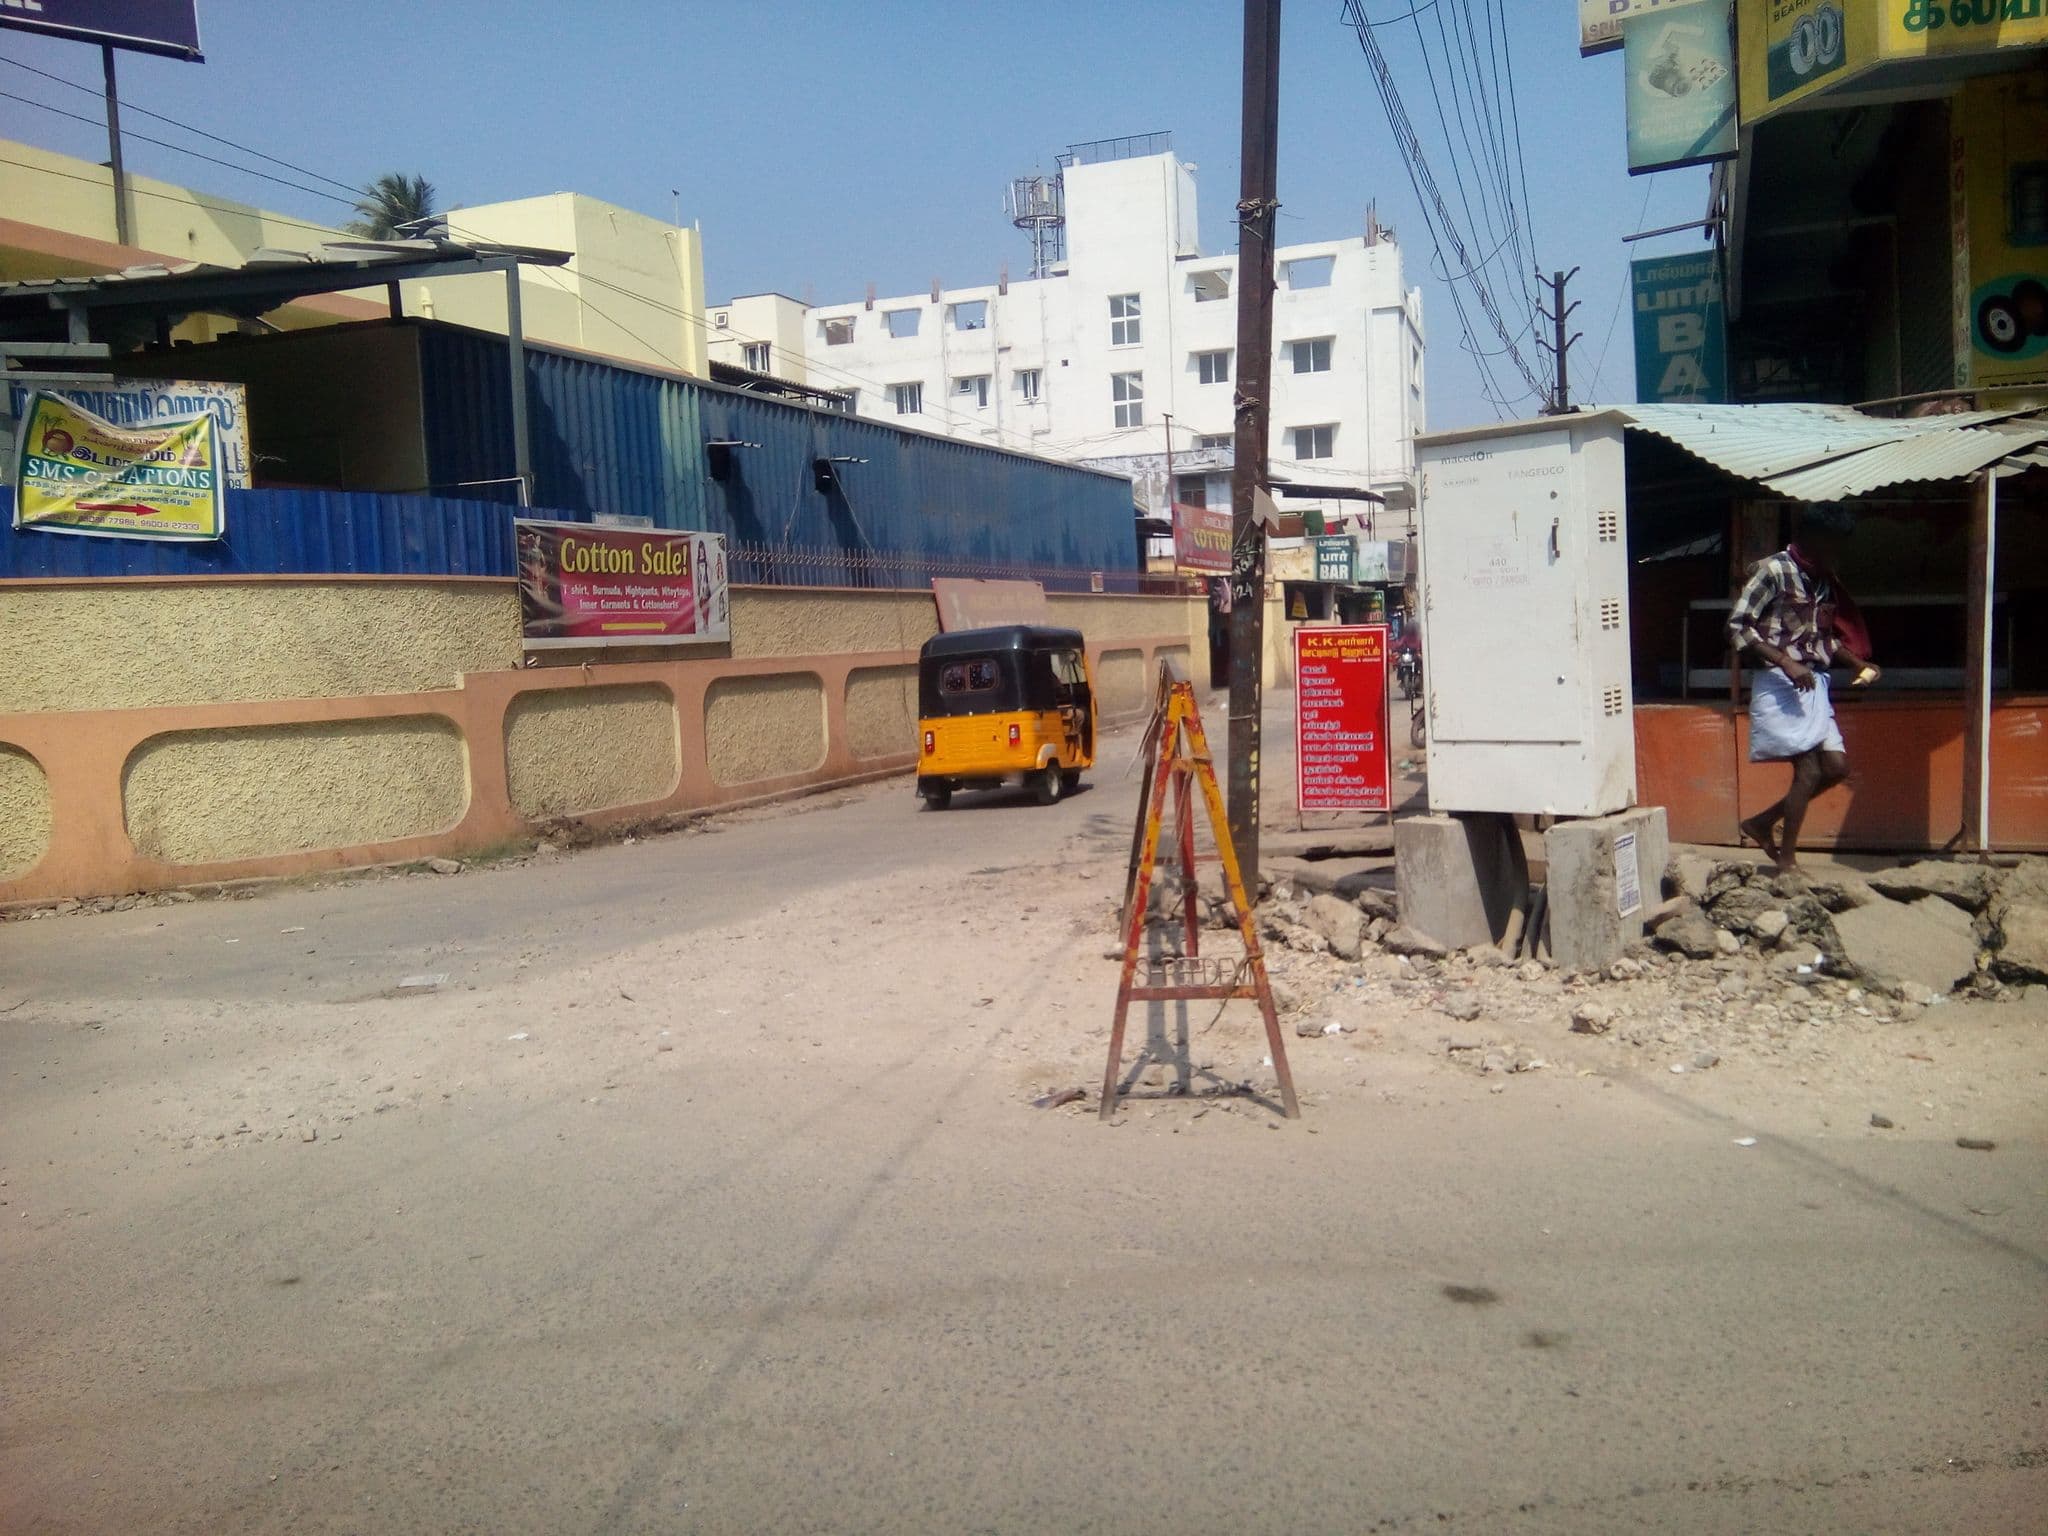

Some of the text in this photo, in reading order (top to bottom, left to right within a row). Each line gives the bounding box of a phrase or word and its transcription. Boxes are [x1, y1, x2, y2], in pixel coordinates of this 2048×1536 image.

[27, 458, 76, 483] SMS
[560, 537, 688, 576] Cotton Sale!
[1320, 564, 1349, 580] BAR
